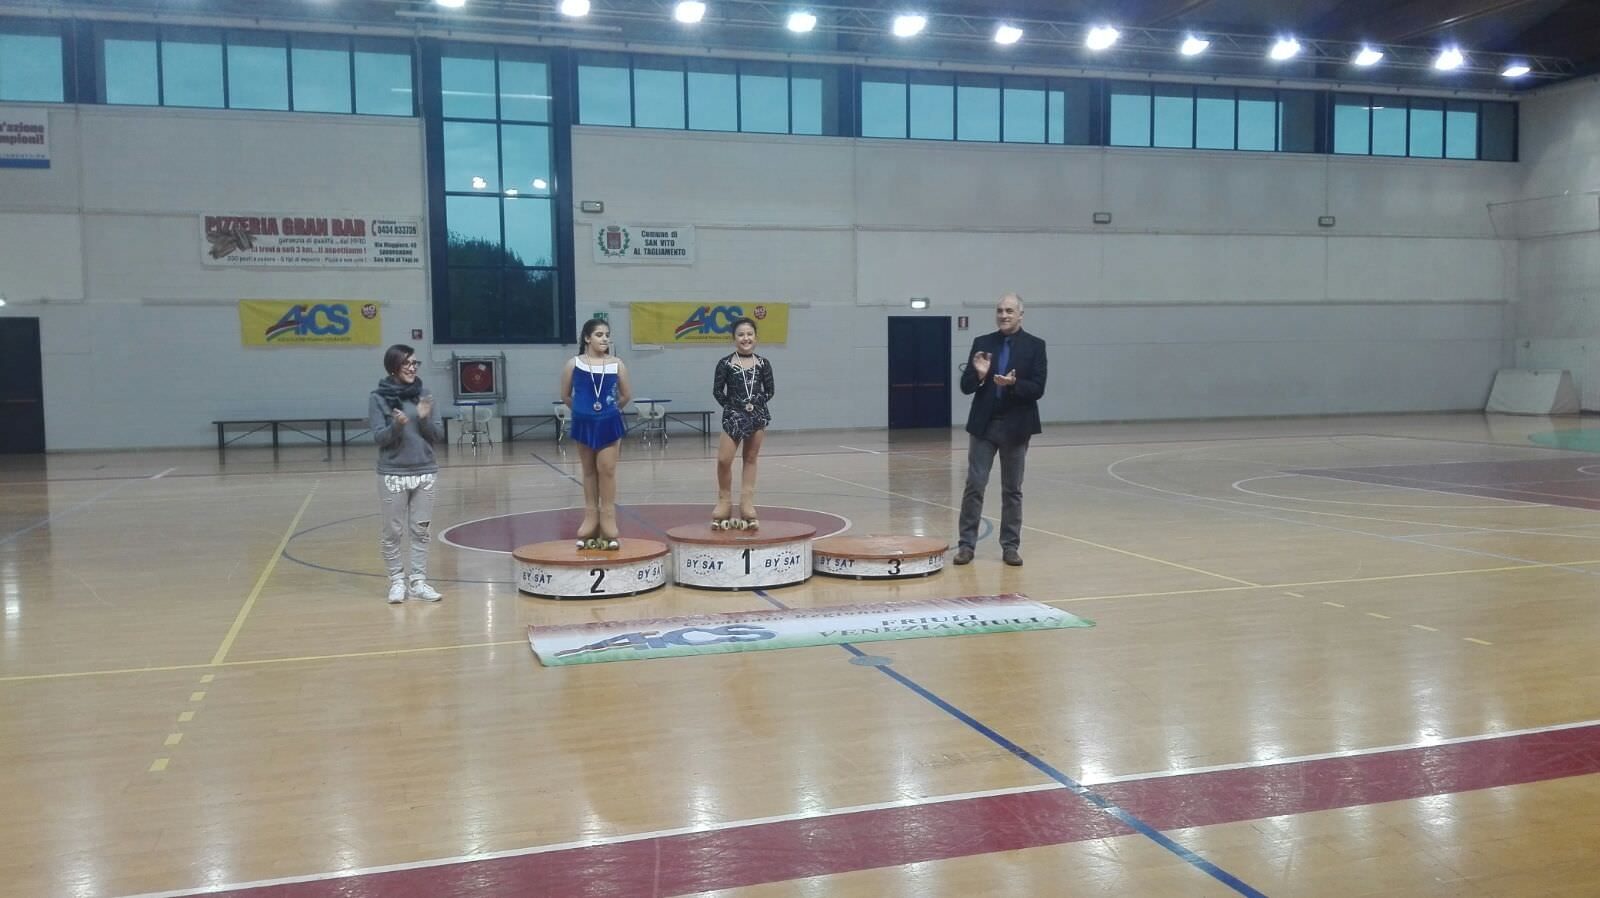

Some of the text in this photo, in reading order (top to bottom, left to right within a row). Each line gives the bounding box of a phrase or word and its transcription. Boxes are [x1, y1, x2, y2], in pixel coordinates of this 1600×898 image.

[204, 216, 366, 237] PIZZERIA GRAN BAR
[641, 230, 678, 238] Comune di
[644, 239, 675, 247] SAN VITO
[633, 247, 687, 256] AL TAGLIAMENTO
[686, 558, 724, 570] BY SAT
[765, 555, 801, 568] BY SAT
[820, 556, 855, 568] BY SAT
[522, 571, 552, 585] BY SAT
[637, 564, 664, 580] BY SAT
[881, 614, 978, 626] FRIULI
[818, 616, 1062, 638] VENEZIA GIULIA
